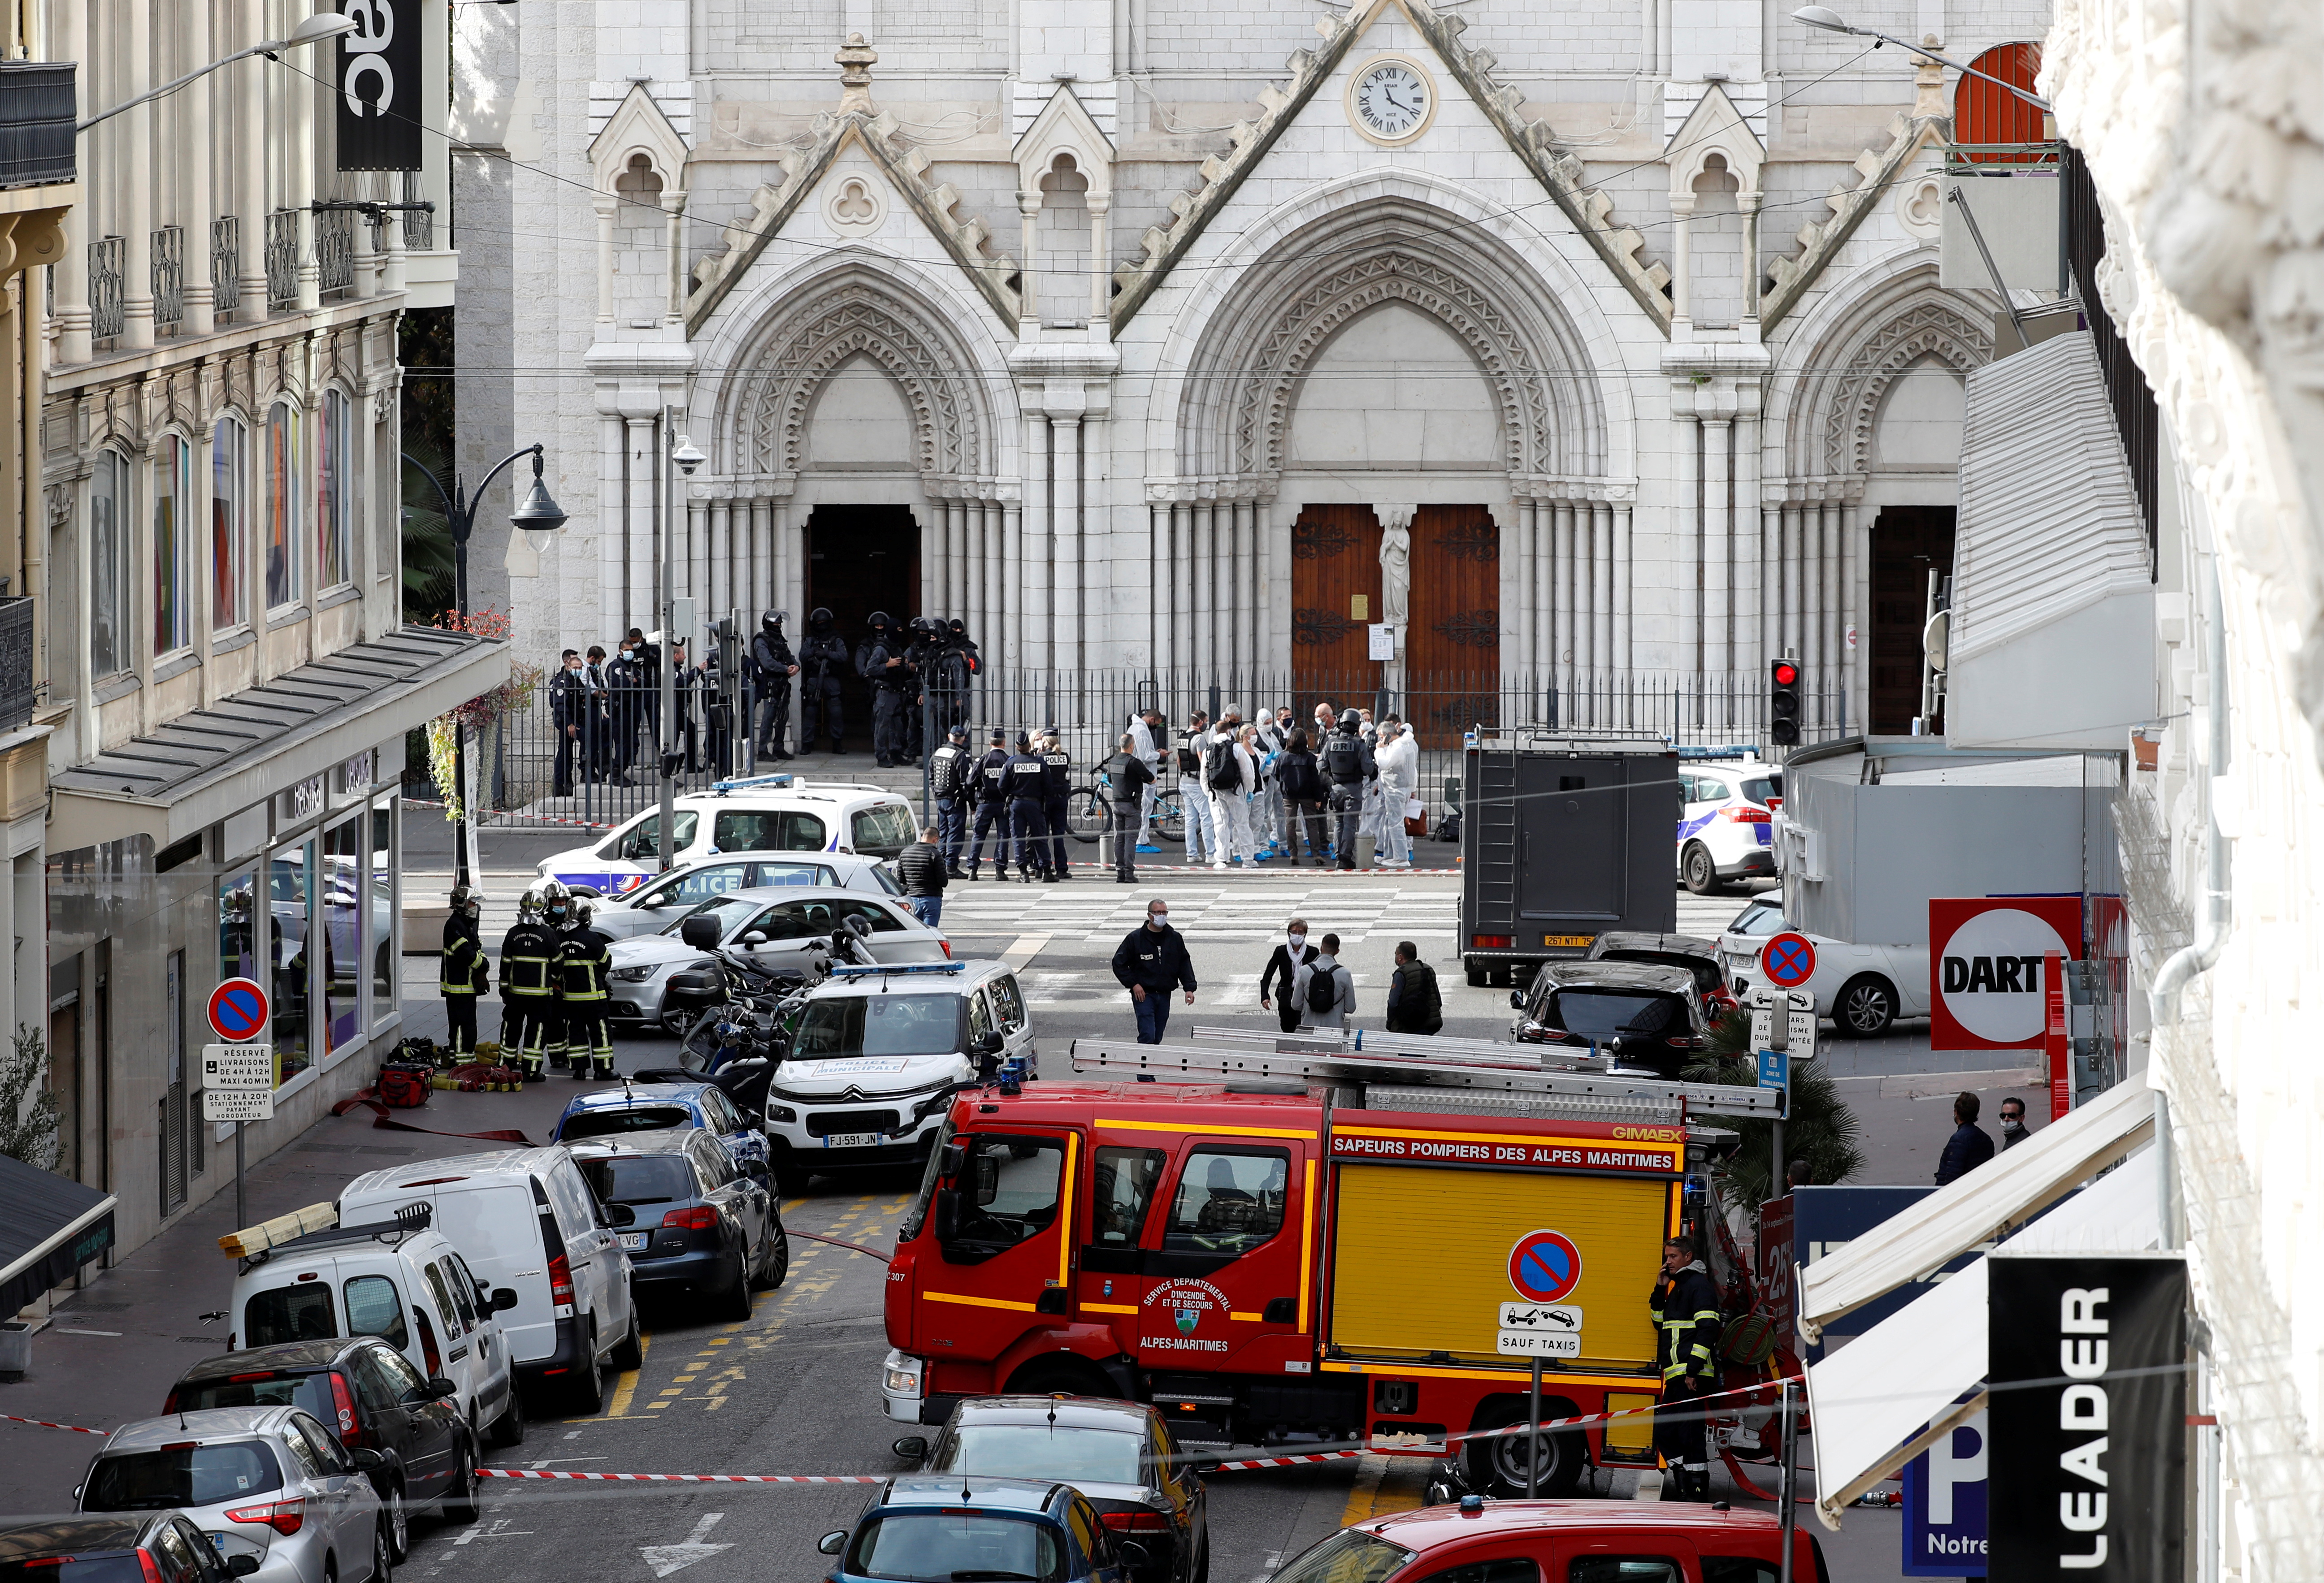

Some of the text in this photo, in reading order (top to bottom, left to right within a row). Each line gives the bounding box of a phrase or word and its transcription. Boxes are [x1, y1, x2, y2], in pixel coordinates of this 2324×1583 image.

[1385, 68, 1396, 79] XII
[675, 877, 737, 893] LICE
[1583, 937, 1591, 945] 75
[816, 1065, 900, 1073] MUNICIPALE
[1760, 1079, 1785, 1088] VERBALISATION
[1613, 1127, 1682, 1142] GIMAEX
[1334, 1138, 1672, 1168] SAPEURS POMPIERS DES ALPES MARITIMES
[1144, 1278, 1231, 1311] SERVICE DEPARTEMENTAL
[1171, 1290, 1206, 1300] D'INCENDIE
[1162, 1298, 1171, 1307] ET
[1183, 1300, 1213, 1310] SECOURS
[1140, 1336, 1228, 1352] ALPES-MARITIMES
[1503, 1338, 1575, 1350] SAUF TAXIS
[2060, 1288, 2109, 1568] LEADER
[1929, 1404, 1988, 1524] P
